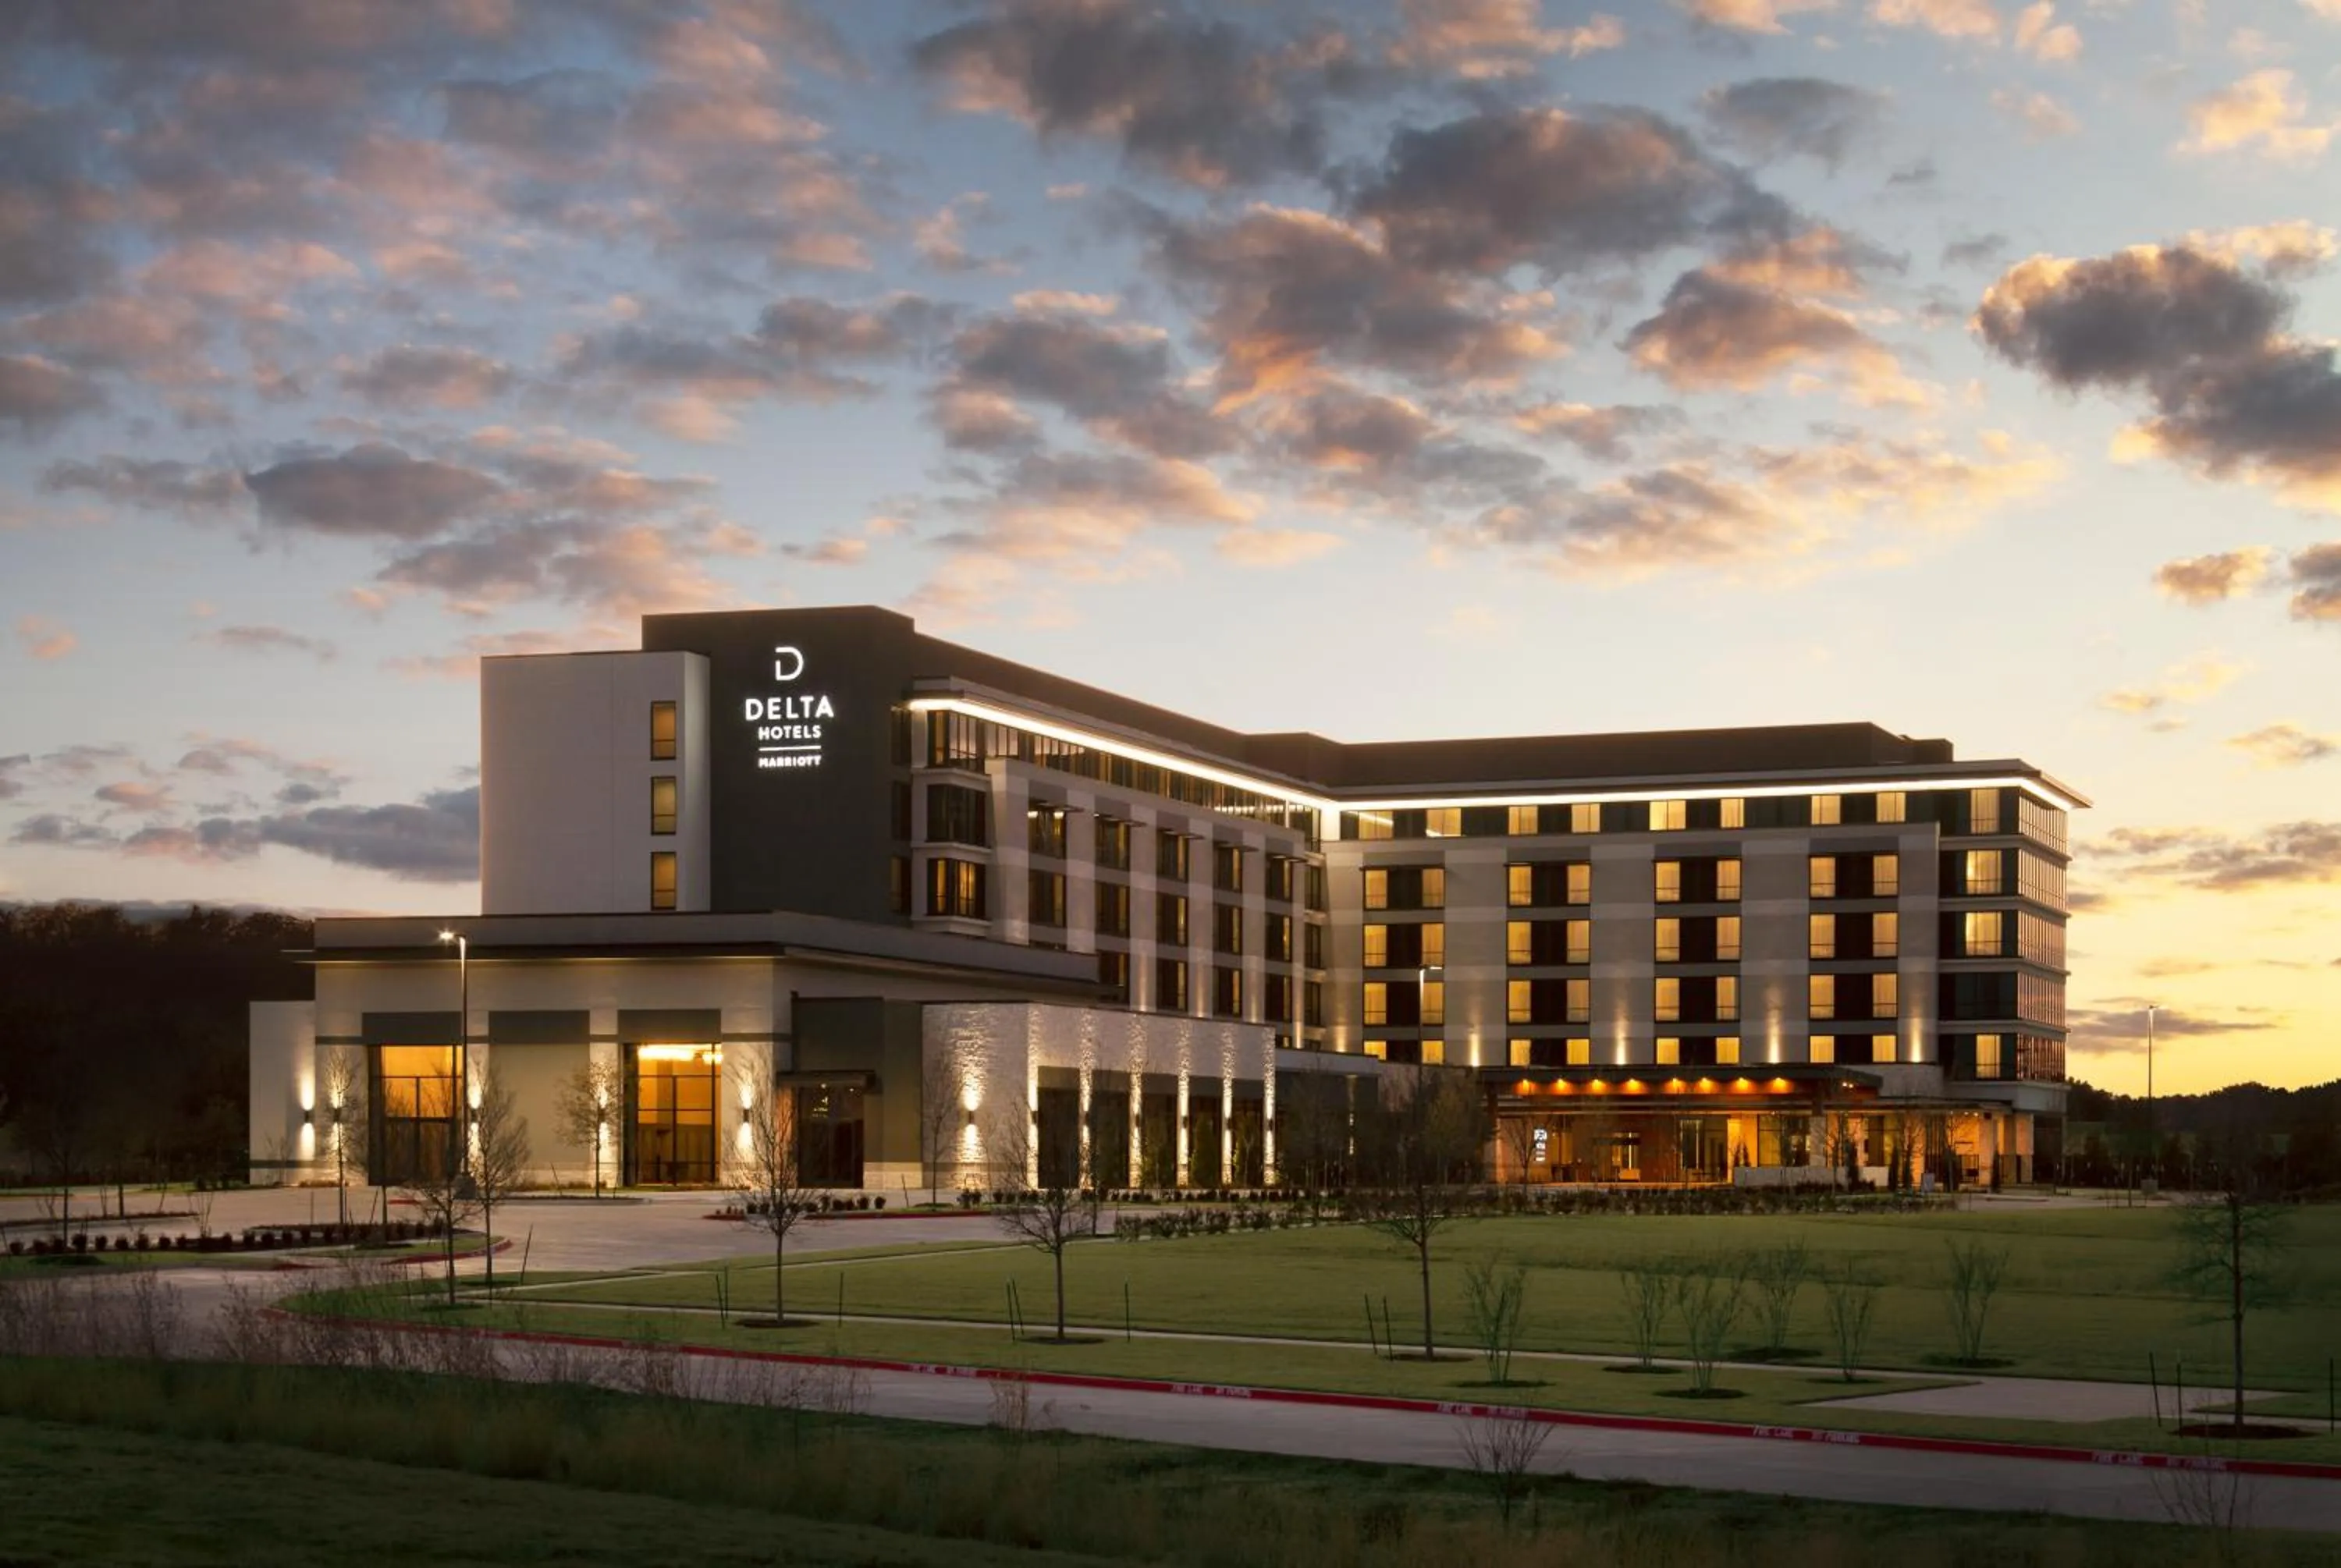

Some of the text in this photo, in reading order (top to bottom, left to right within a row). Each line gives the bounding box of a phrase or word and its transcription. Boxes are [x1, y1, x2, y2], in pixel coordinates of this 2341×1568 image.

[775, 646, 805, 681] D
[744, 695, 835, 721] DELTA
[757, 725, 822, 740] HOTELS
[758, 755, 822, 768] MARRIOTT
